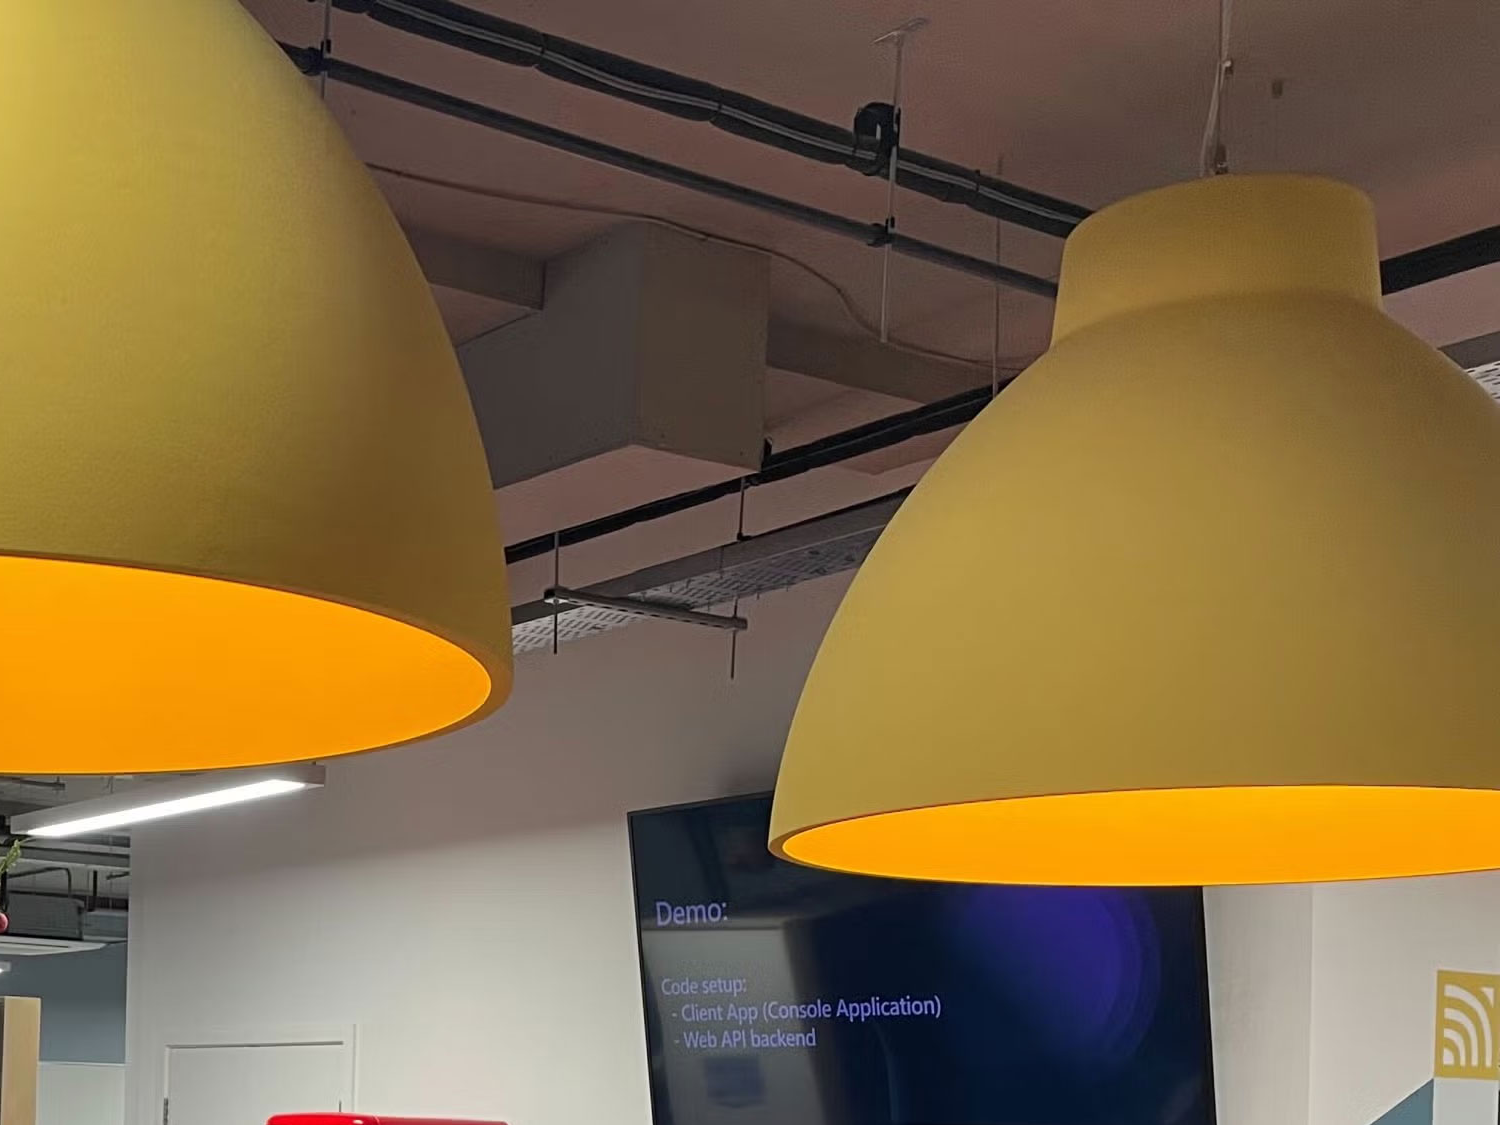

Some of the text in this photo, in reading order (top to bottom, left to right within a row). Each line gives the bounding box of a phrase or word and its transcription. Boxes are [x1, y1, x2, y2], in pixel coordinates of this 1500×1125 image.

[655, 901, 728, 927] Demo:
[661, 977, 747, 997] Code setup:
[681, 1004, 724, 1022] Client
[727, 1003, 759, 1025] App
[763, 999, 832, 1022] (Console
[836, 995, 942, 1022] Application)
[683, 1029, 717, 1049] Web
[721, 1029, 746, 1048] API
[750, 1027, 817, 1048] backend
